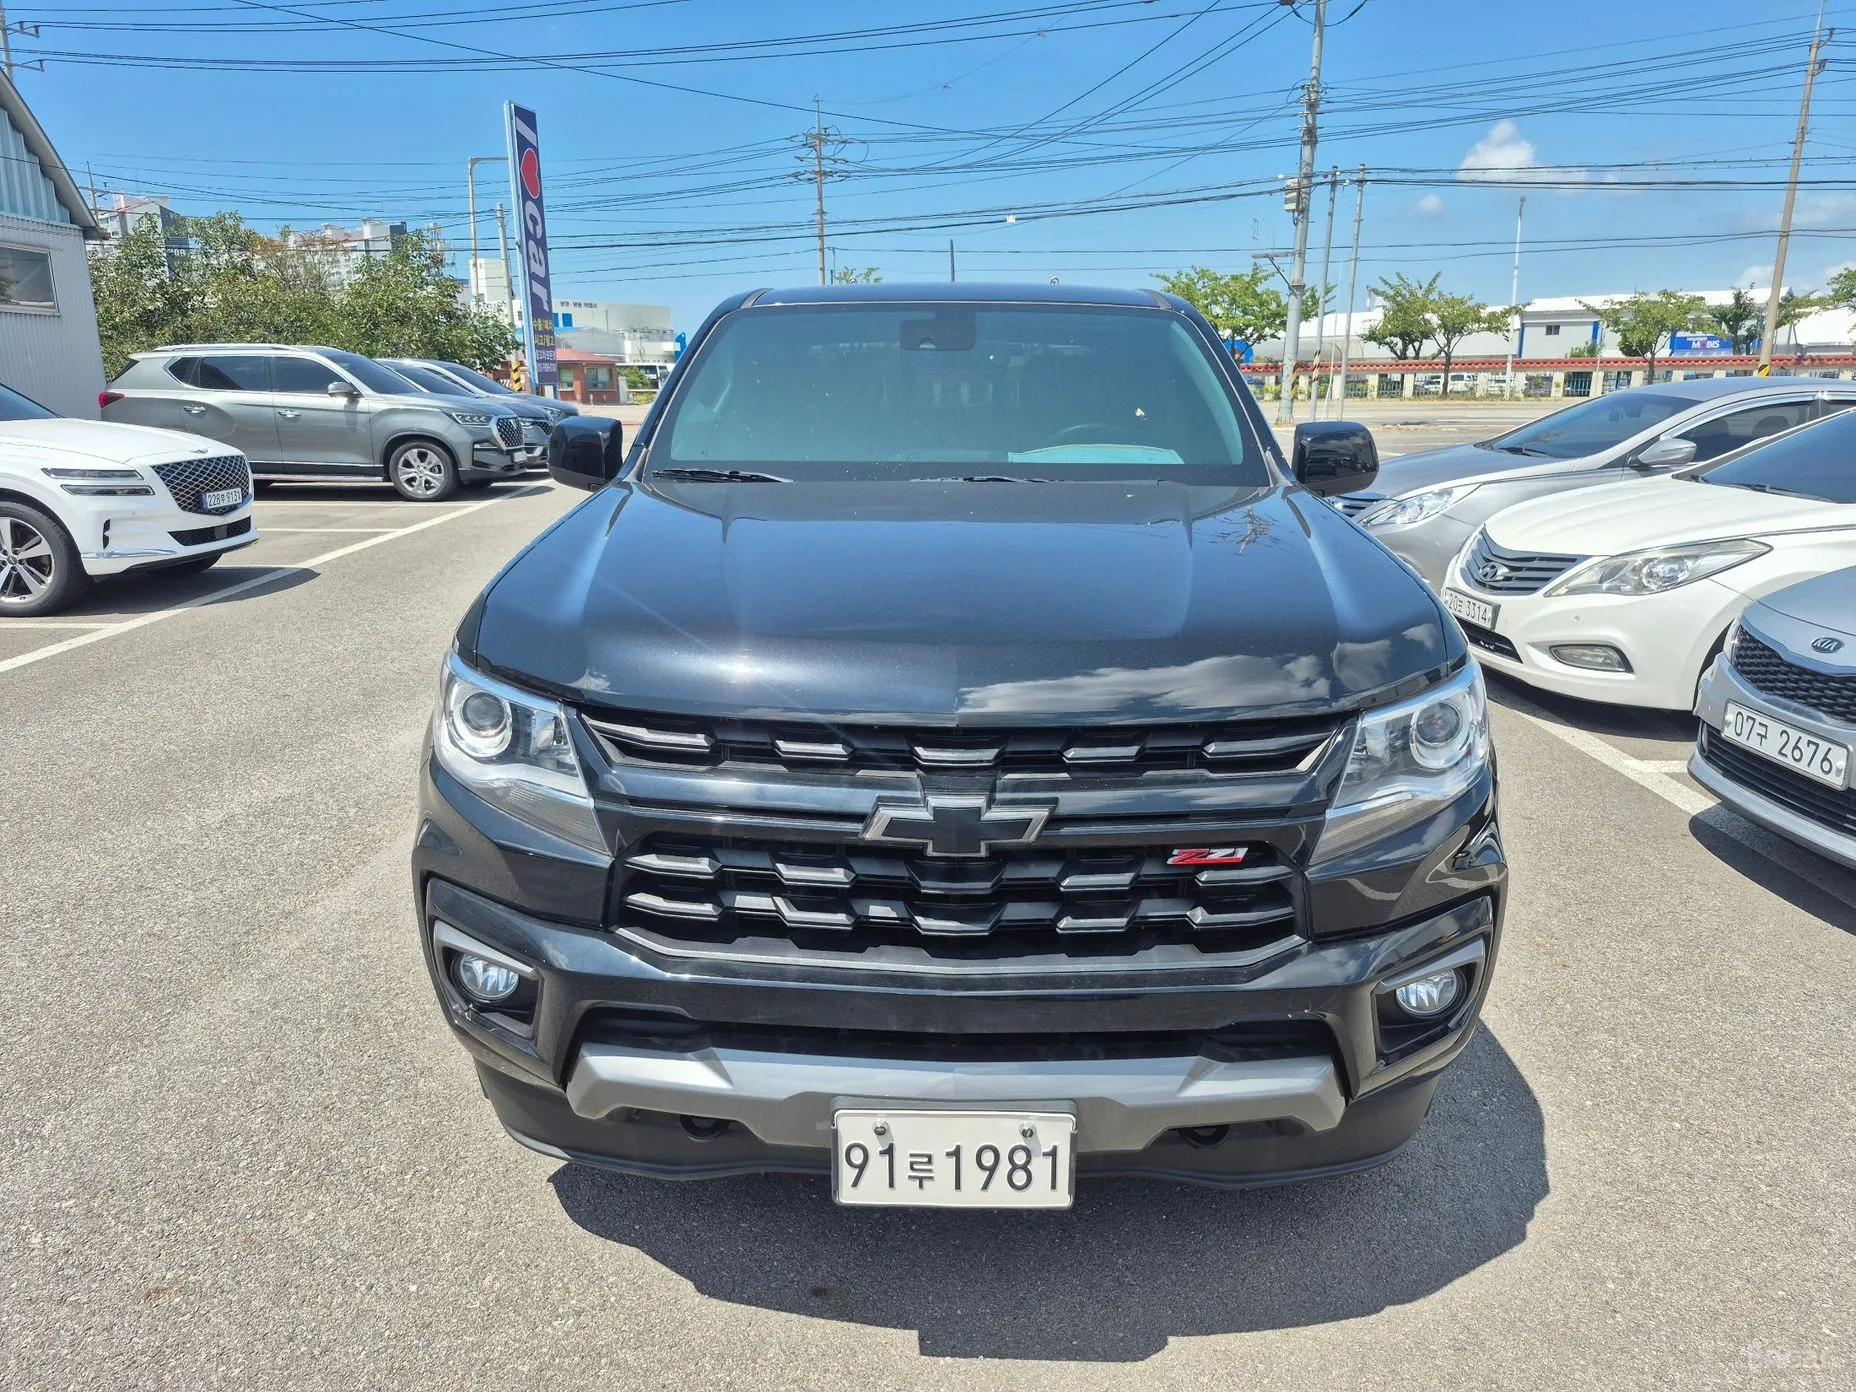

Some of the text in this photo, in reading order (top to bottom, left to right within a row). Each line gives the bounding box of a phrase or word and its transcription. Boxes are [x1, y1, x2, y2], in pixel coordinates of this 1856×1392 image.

[526, 200, 550, 312] car
[1465, 600, 1488, 624] 3314
[1813, 638, 1836, 651] KIA
[1734, 711, 1833, 776] 07구 2676
